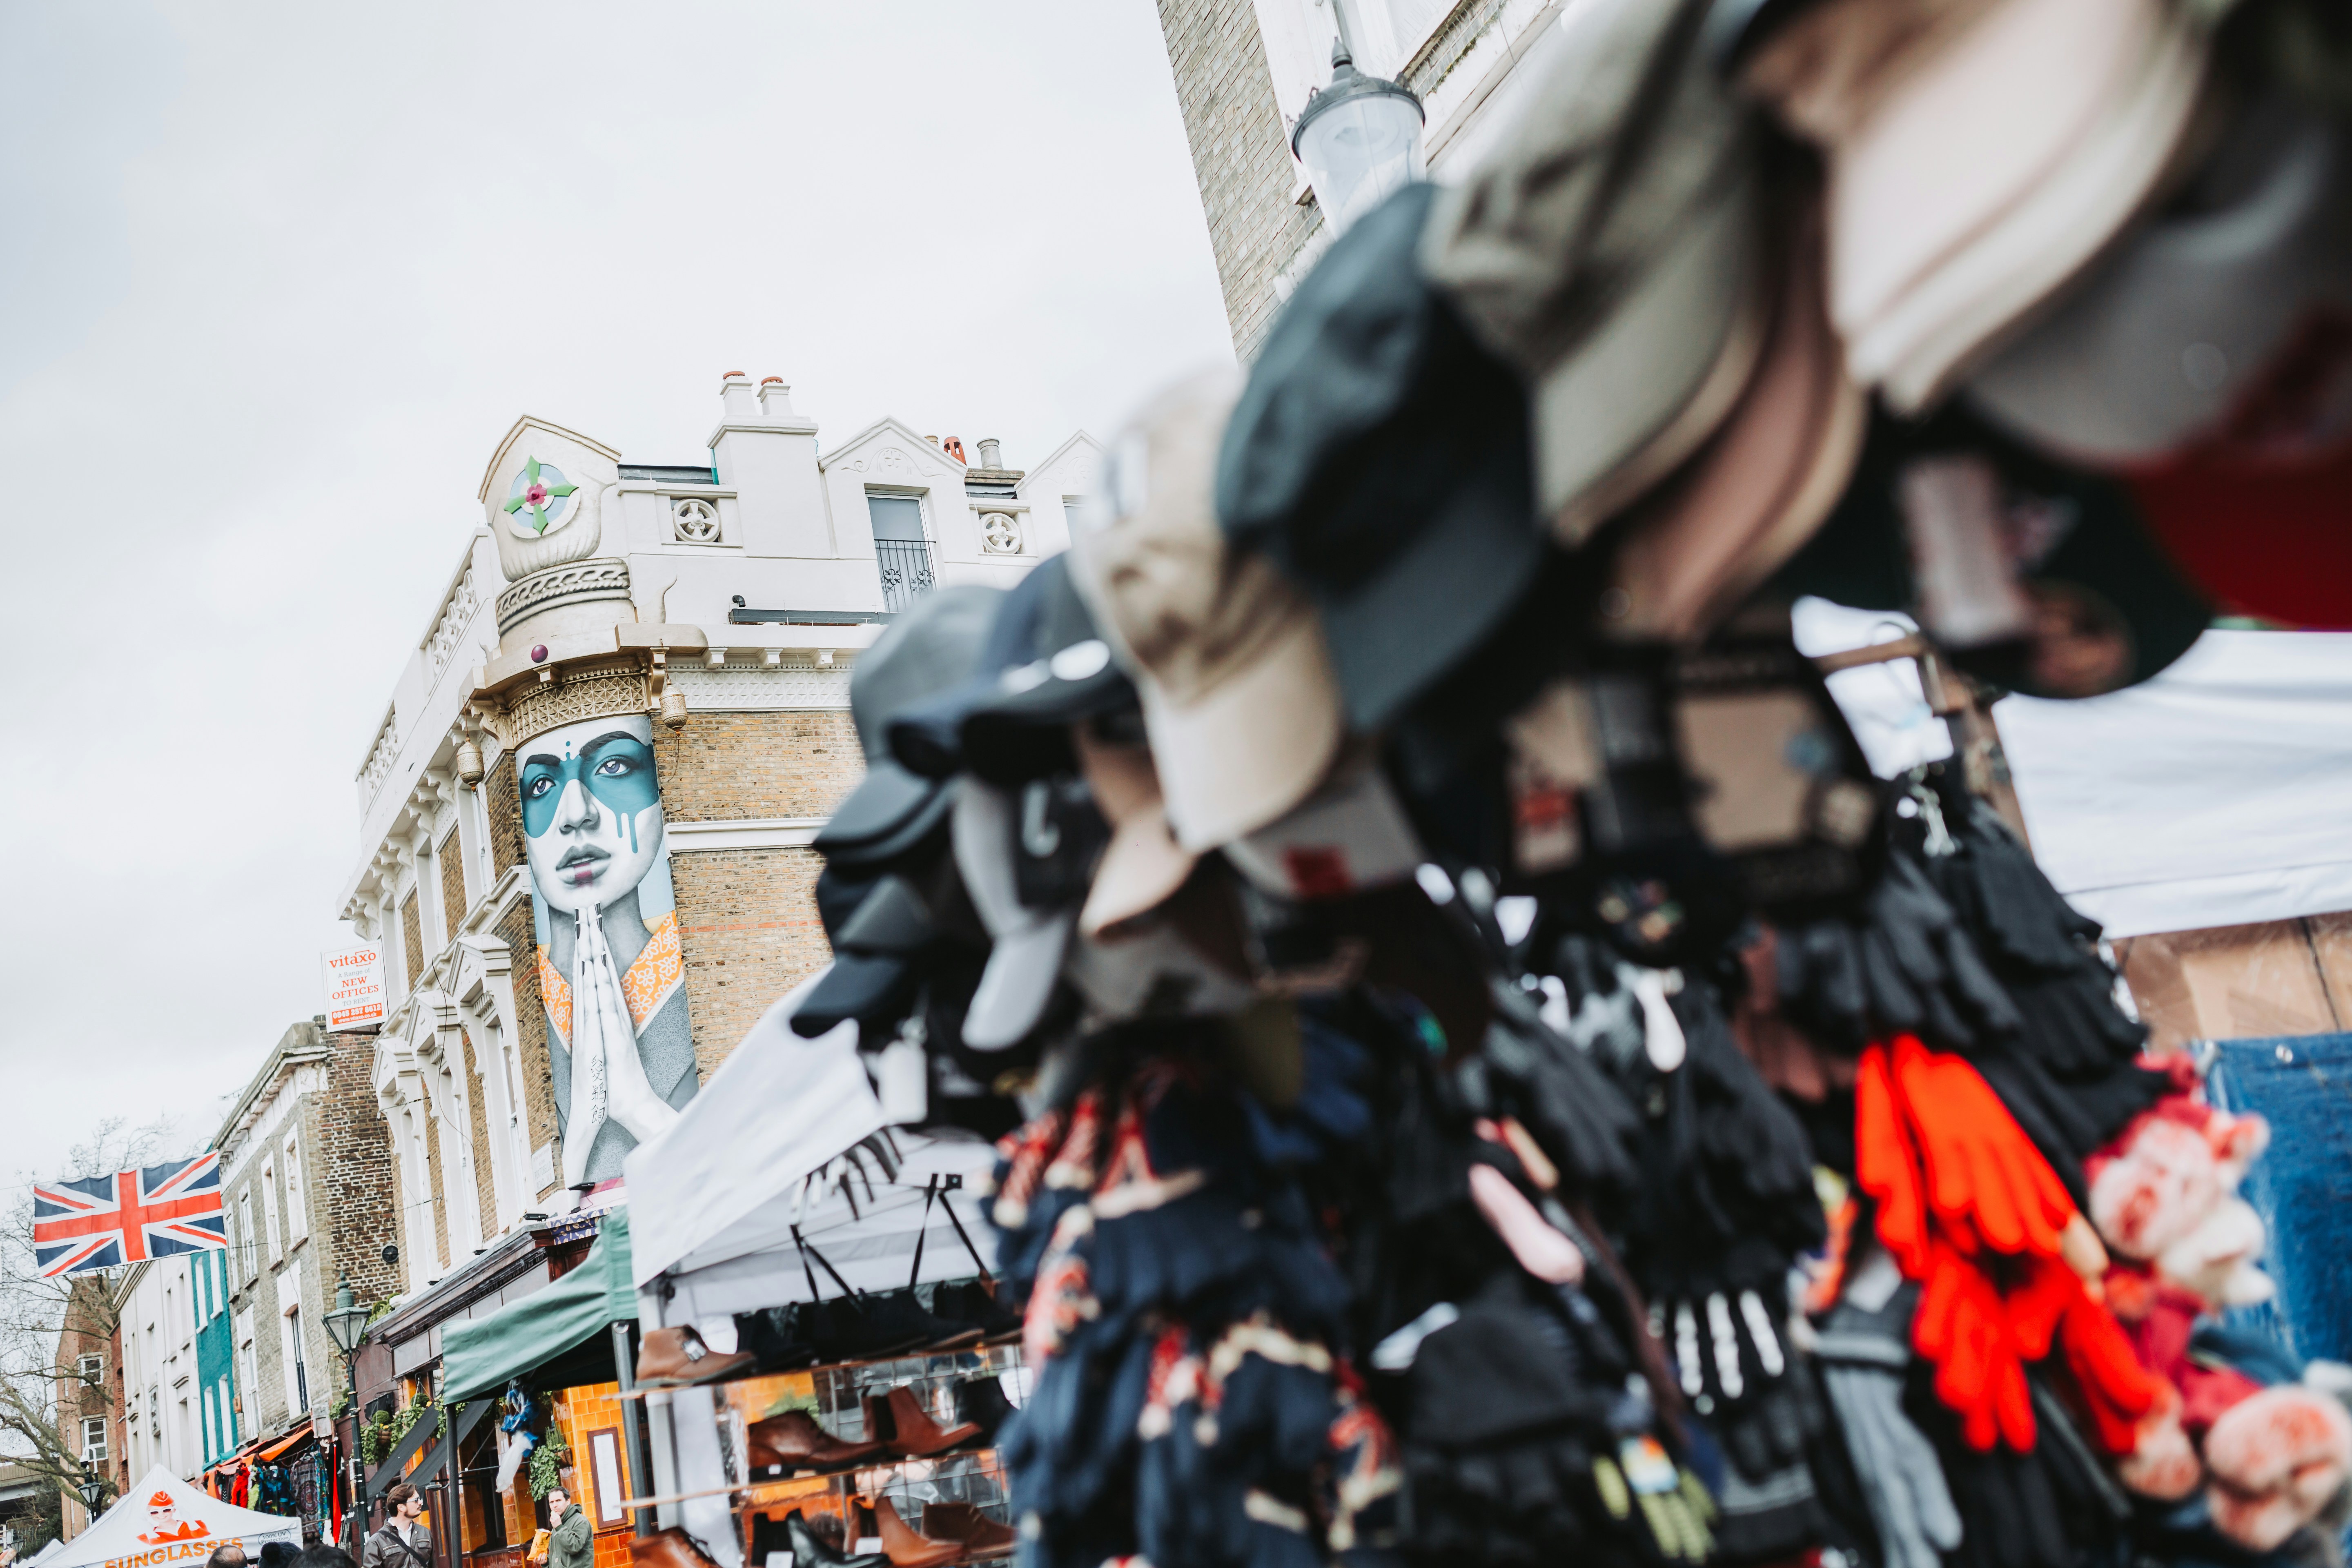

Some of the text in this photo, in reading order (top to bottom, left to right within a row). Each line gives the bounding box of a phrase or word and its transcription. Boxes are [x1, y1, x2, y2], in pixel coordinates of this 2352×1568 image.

[329, 952, 376, 968] vitaxo
[342, 976, 367, 988] NEW
[332, 984, 379, 1000] OFFICES
[333, 1010, 350, 1019] 0845
[351, 1007, 363, 1016] 257
